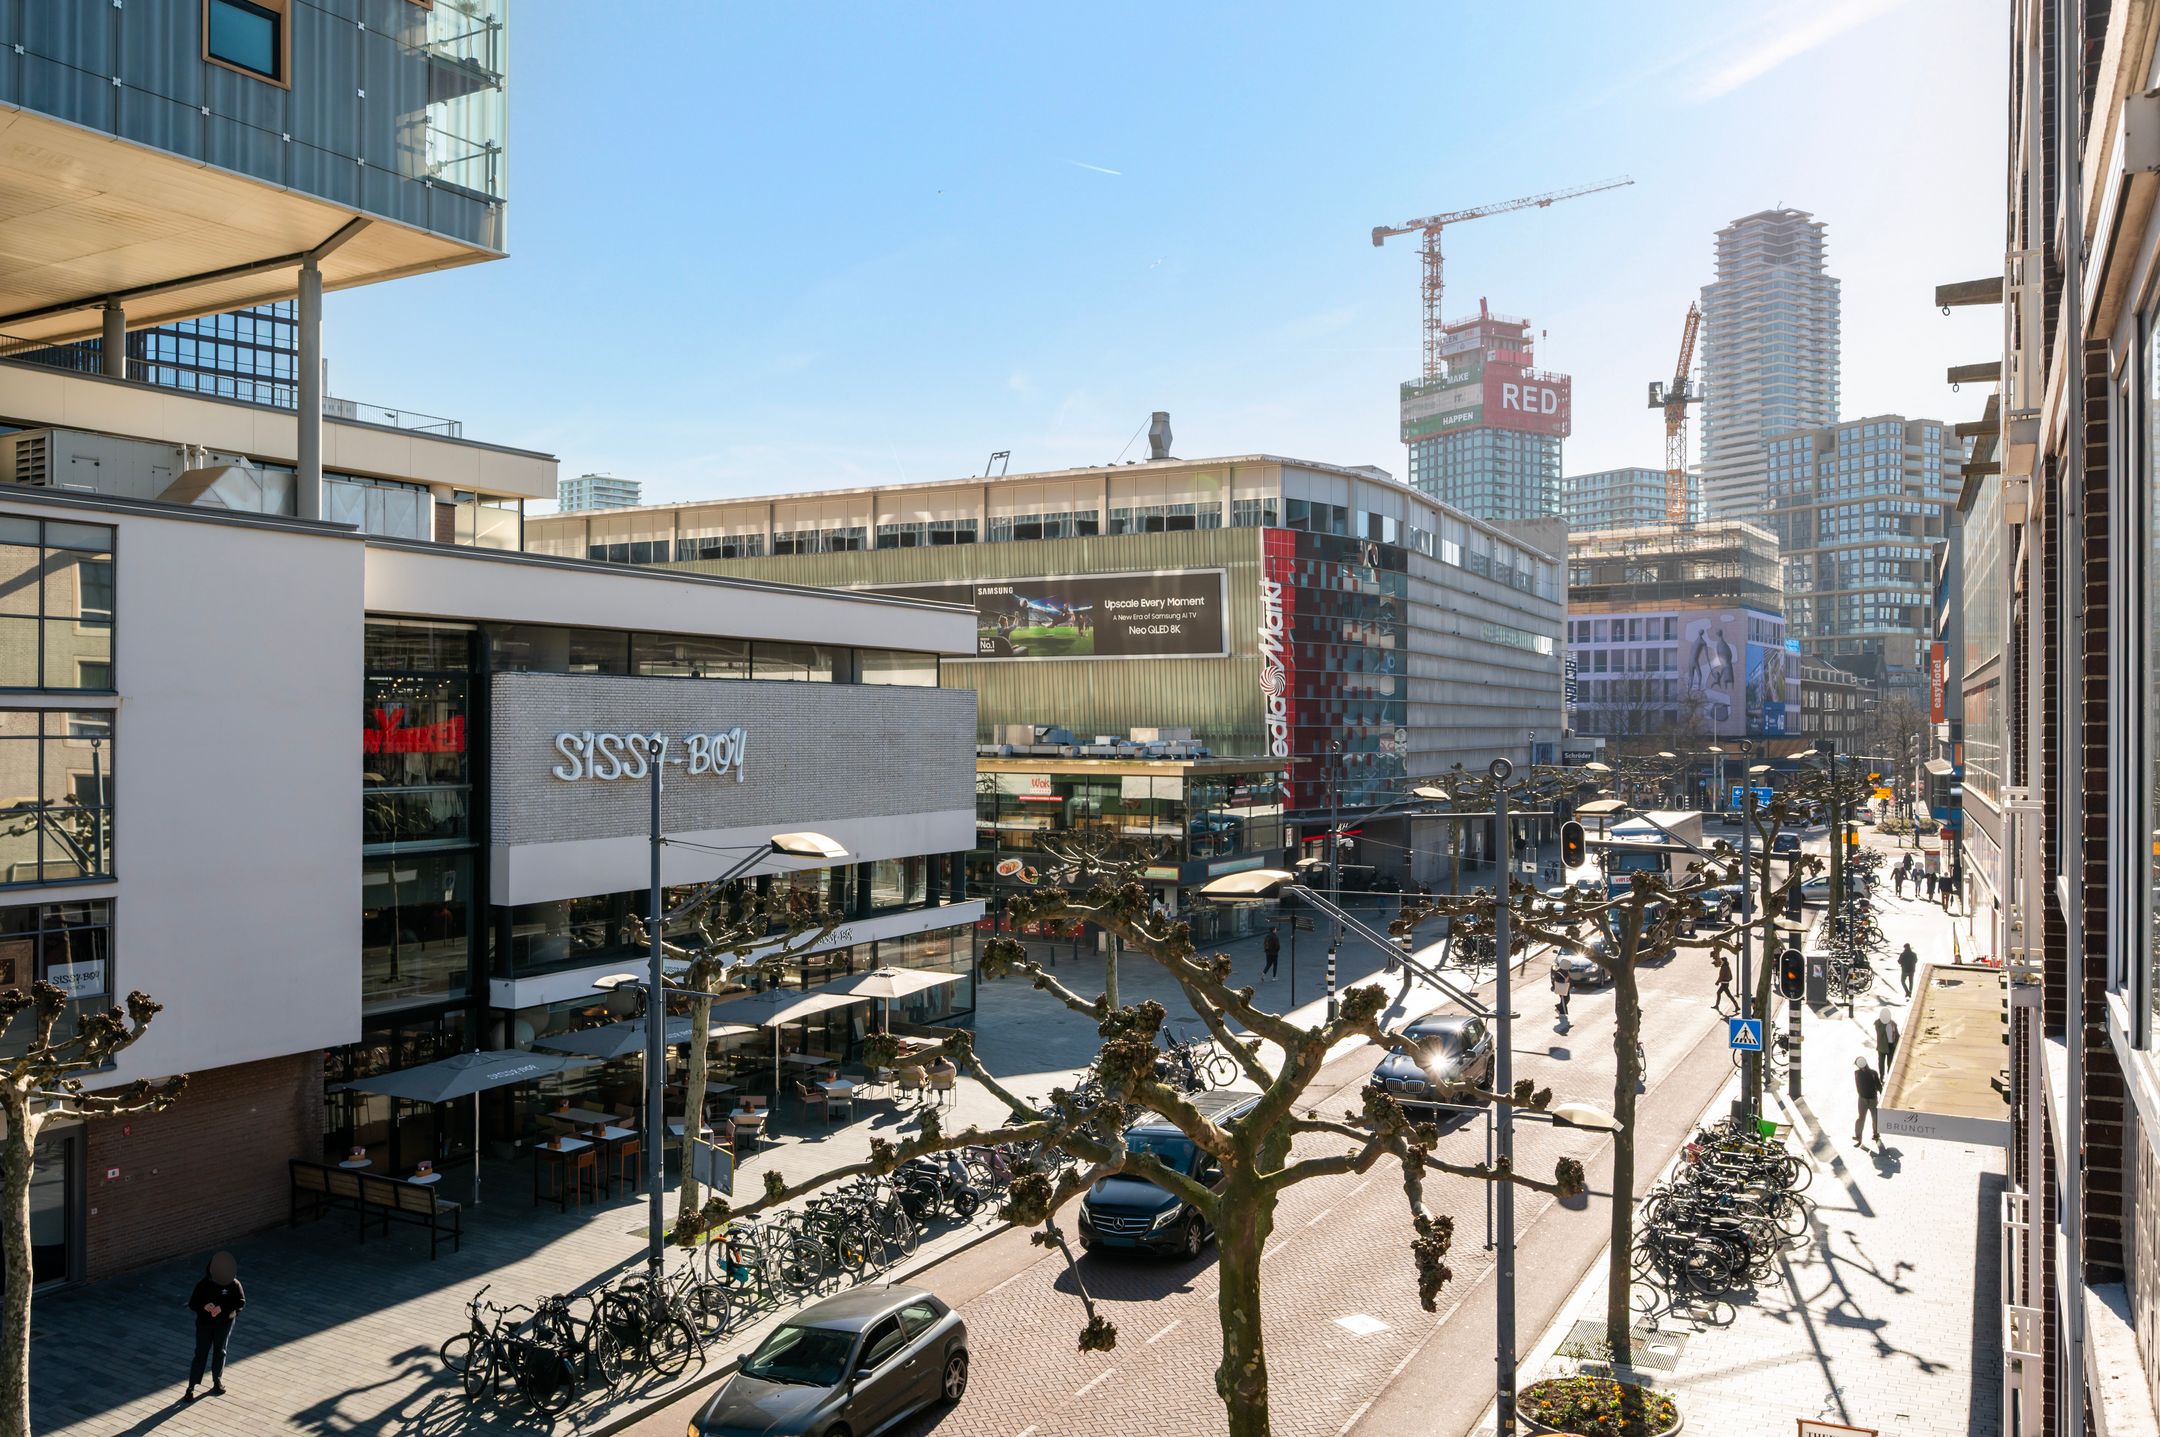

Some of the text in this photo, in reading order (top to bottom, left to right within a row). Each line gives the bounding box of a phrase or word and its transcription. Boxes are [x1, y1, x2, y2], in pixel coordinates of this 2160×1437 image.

[1447, 371, 1470, 385] MAKE
[1502, 383, 1558, 415] RED
[1442, 411, 1474, 426] HAPPEN
[977, 586, 1014, 596] SAMSUNG
[1104, 596, 1205, 611] Upscale Every Moment
[1118, 613, 1132, 621] New
[1143, 612, 1151, 620] of
[1151, 612, 1181, 622] Samsung
[1188, 611, 1198, 619] TV
[1128, 624, 1181, 636] Neo QLED 8K
[1258, 577, 1286, 672] Markt
[980, 640, 995, 649] No.1
[1564, 659, 1577, 704] ACTION
[1932, 659, 1943, 709] easyHotel
[1031, 777, 1050, 788] Wok
[1886, 1122, 1937, 1135] BRUNOTT
